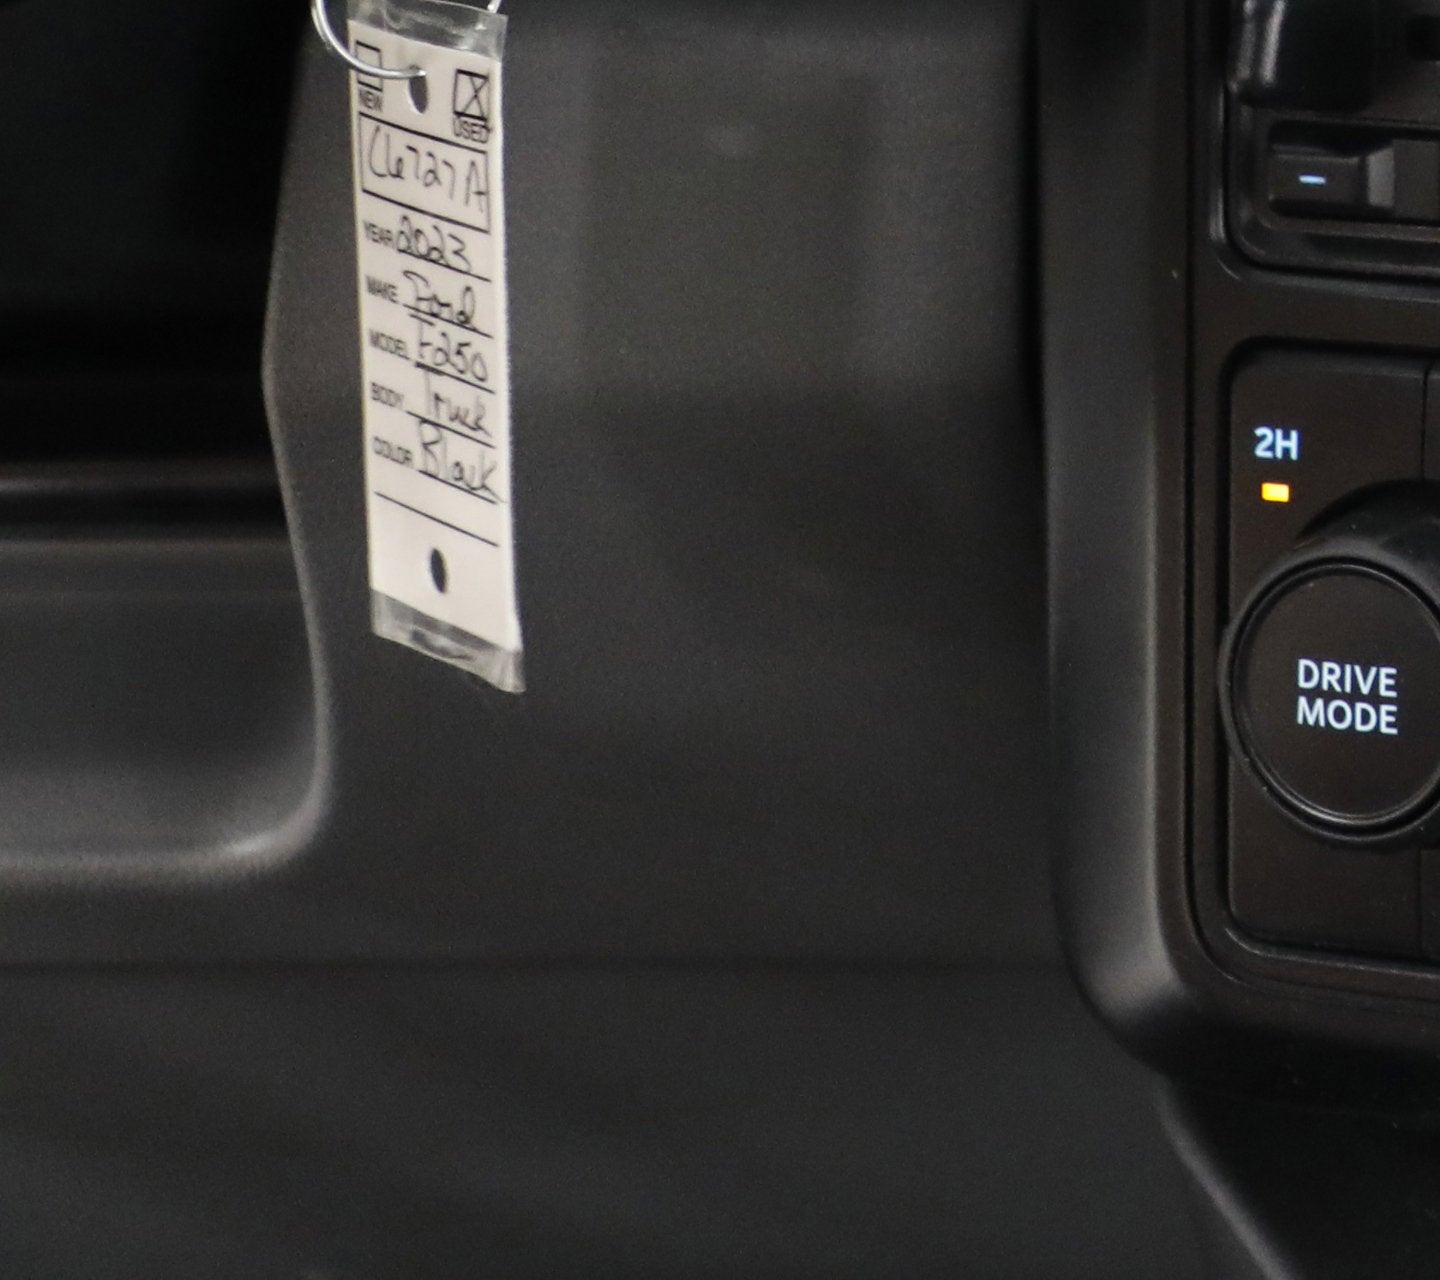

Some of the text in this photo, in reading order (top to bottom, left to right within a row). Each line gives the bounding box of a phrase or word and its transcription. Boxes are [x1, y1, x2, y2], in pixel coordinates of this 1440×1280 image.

[1255, 427, 1299, 459] 2H
[1297, 658, 1398, 697] DRIVE
[1297, 697, 1398, 736] MODE
